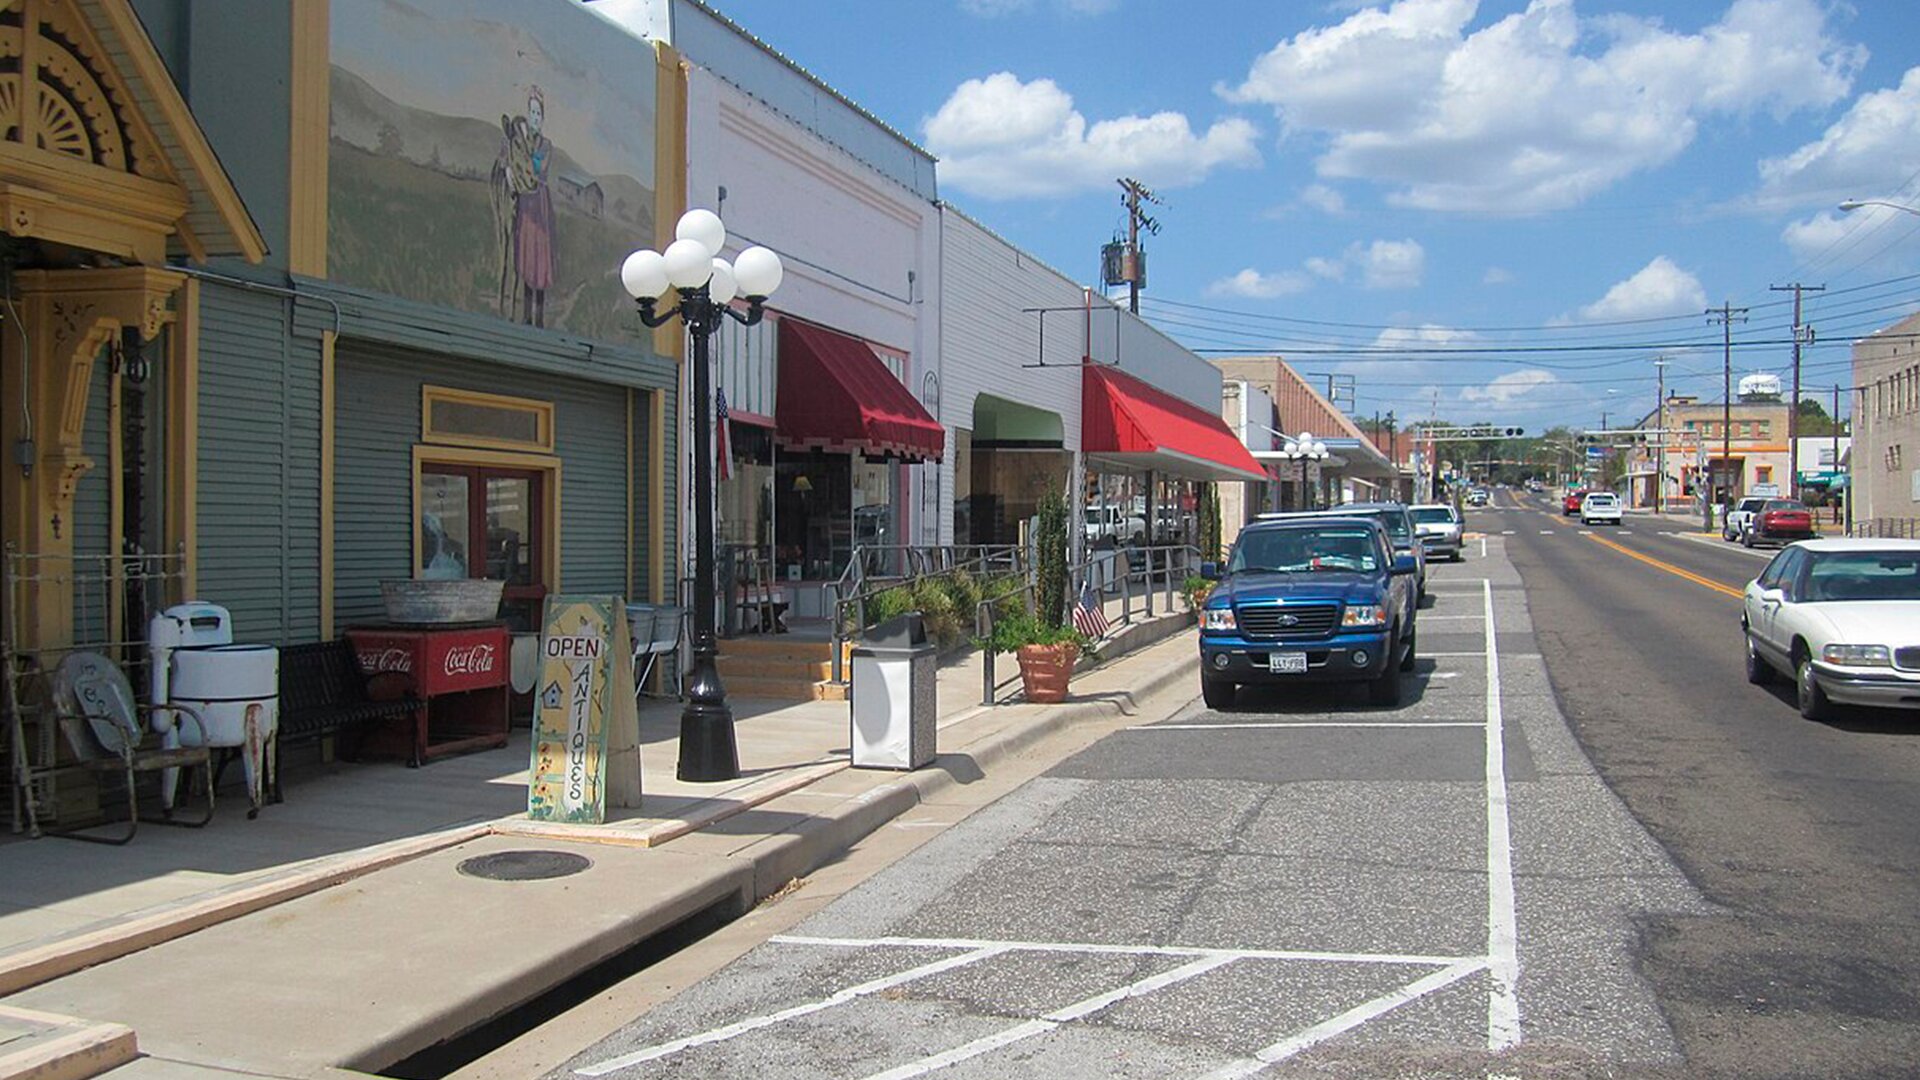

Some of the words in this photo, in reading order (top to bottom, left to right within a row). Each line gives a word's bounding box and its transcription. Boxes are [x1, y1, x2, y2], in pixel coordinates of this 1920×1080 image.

[444, 644, 494, 676] Coca-Cola
[547, 638, 599, 657] OPEN
[569, 663, 590, 800] ANTIQUES
